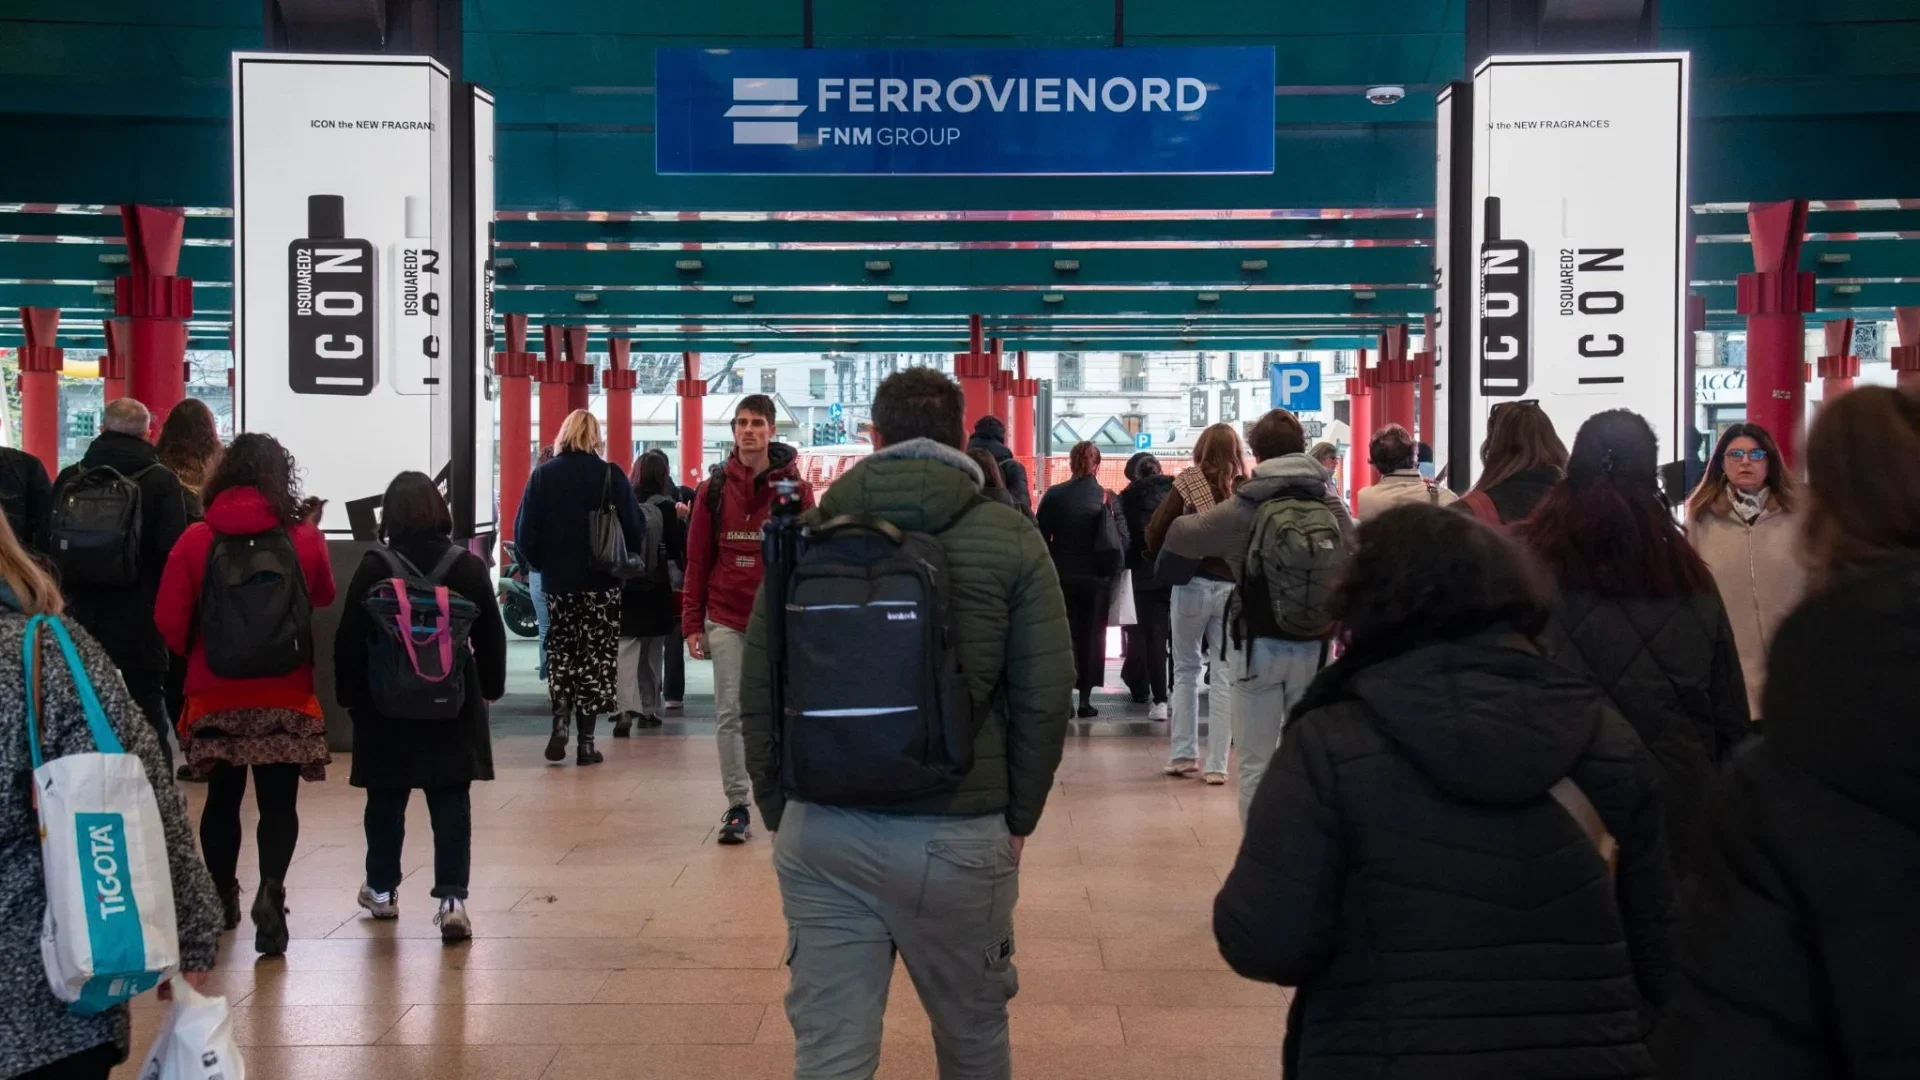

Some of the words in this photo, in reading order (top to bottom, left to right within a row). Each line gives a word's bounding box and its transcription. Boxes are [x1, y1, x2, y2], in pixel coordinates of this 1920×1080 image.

[817, 76, 1208, 113] FERROVIENORD
[310, 120, 335, 129] ICON
[338, 120, 353, 129] the
[356, 121, 379, 129] NEW
[817, 127, 872, 147] FNM
[876, 127, 961, 147] GROUP
[1496, 121, 1511, 130] the
[1514, 121, 1537, 130] NEW
[1540, 120, 1610, 129] FRAGRANCES
[297, 248, 312, 316] DSQUARED2
[404, 248, 418, 316] DSQUARED2
[1560, 248, 1574, 316] DSQUARED2
[315, 248, 363, 387] ICON
[1483, 249, 1519, 387] ICON
[1578, 248, 1624, 385] ICON
[1281, 369, 1310, 406] P
[1138, 435, 1148, 447] P
